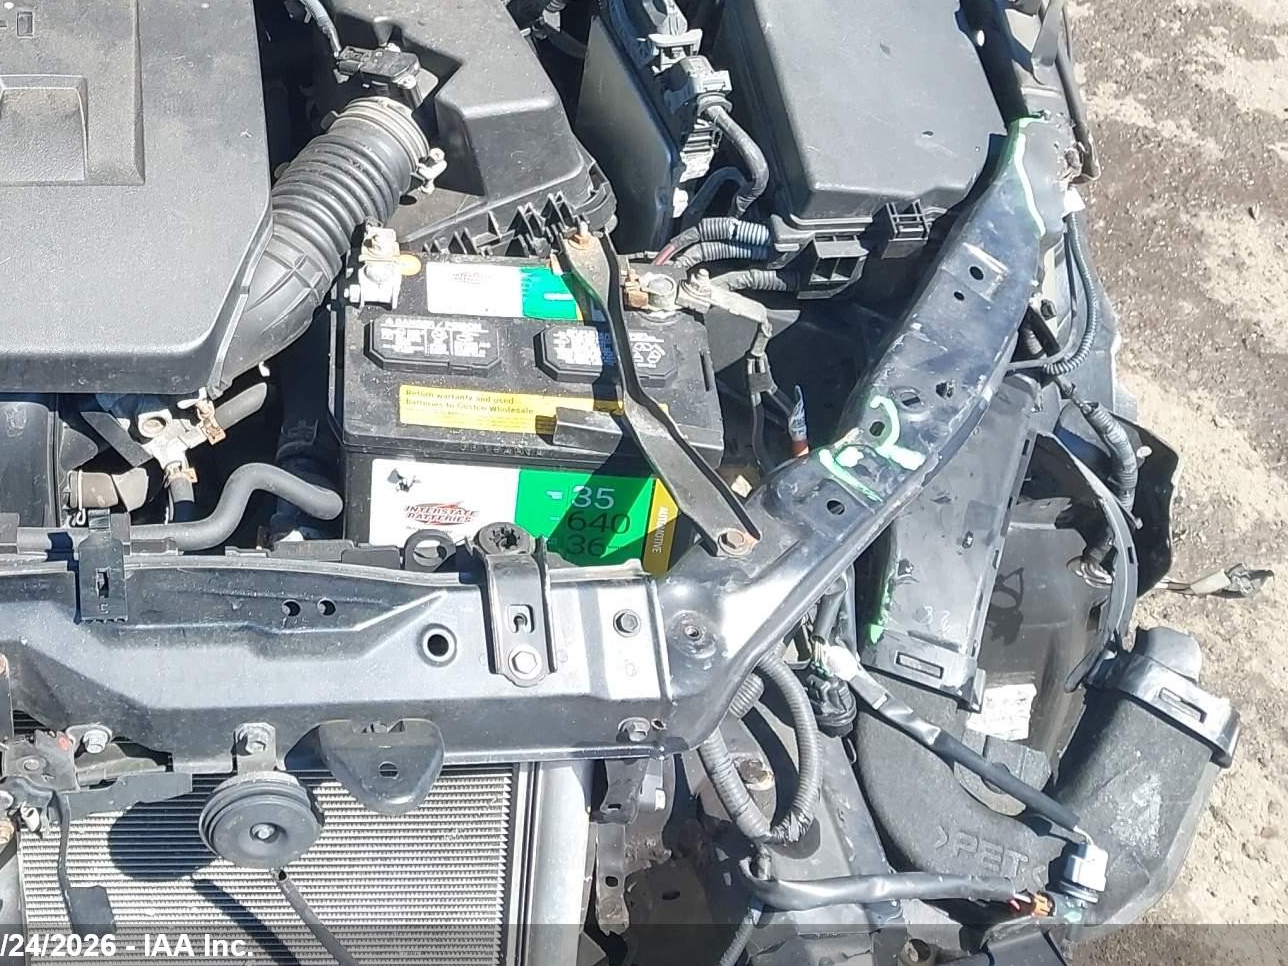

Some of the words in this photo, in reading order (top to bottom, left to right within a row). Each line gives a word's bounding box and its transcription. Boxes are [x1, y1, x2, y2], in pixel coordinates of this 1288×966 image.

[489, 405, 534, 415] Wholesale
[572, 485, 616, 510] 35
[567, 510, 632, 535] 640
[652, 505, 669, 554] AUTOMOTIVE
